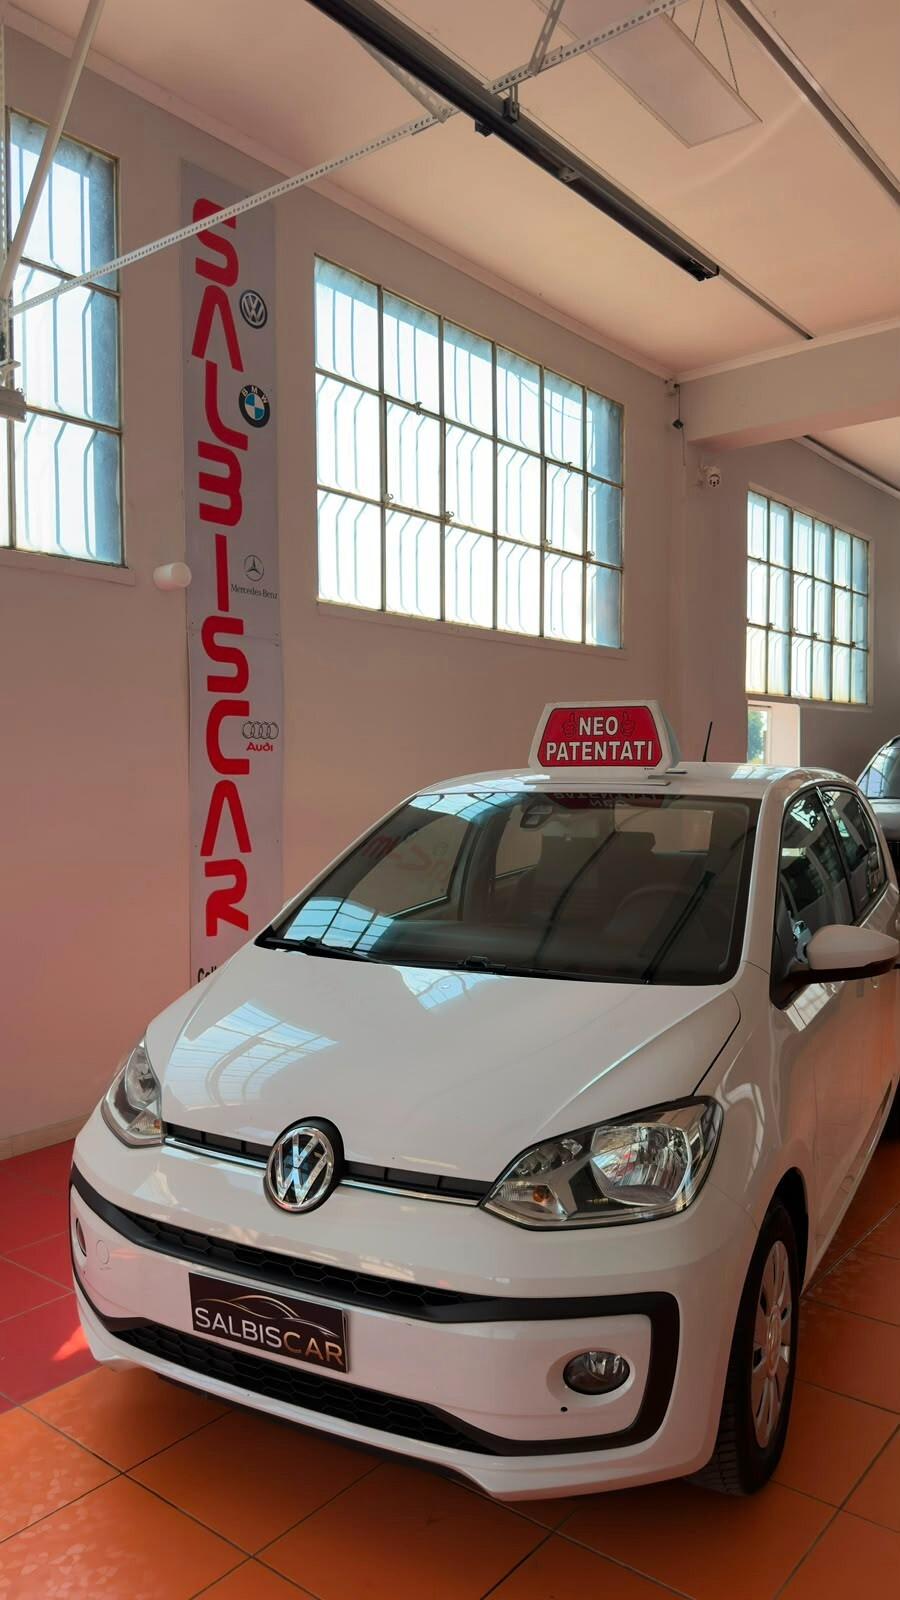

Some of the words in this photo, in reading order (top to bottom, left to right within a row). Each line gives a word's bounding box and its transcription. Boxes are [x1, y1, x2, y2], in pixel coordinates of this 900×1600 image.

[192, 198, 251, 937] SALBISCAR
[579, 716, 619, 736] NEO
[246, 742, 273, 752] Audi
[546, 741, 653, 761] PATENTATI
[194, 1307, 344, 1366] SALBISCAR
